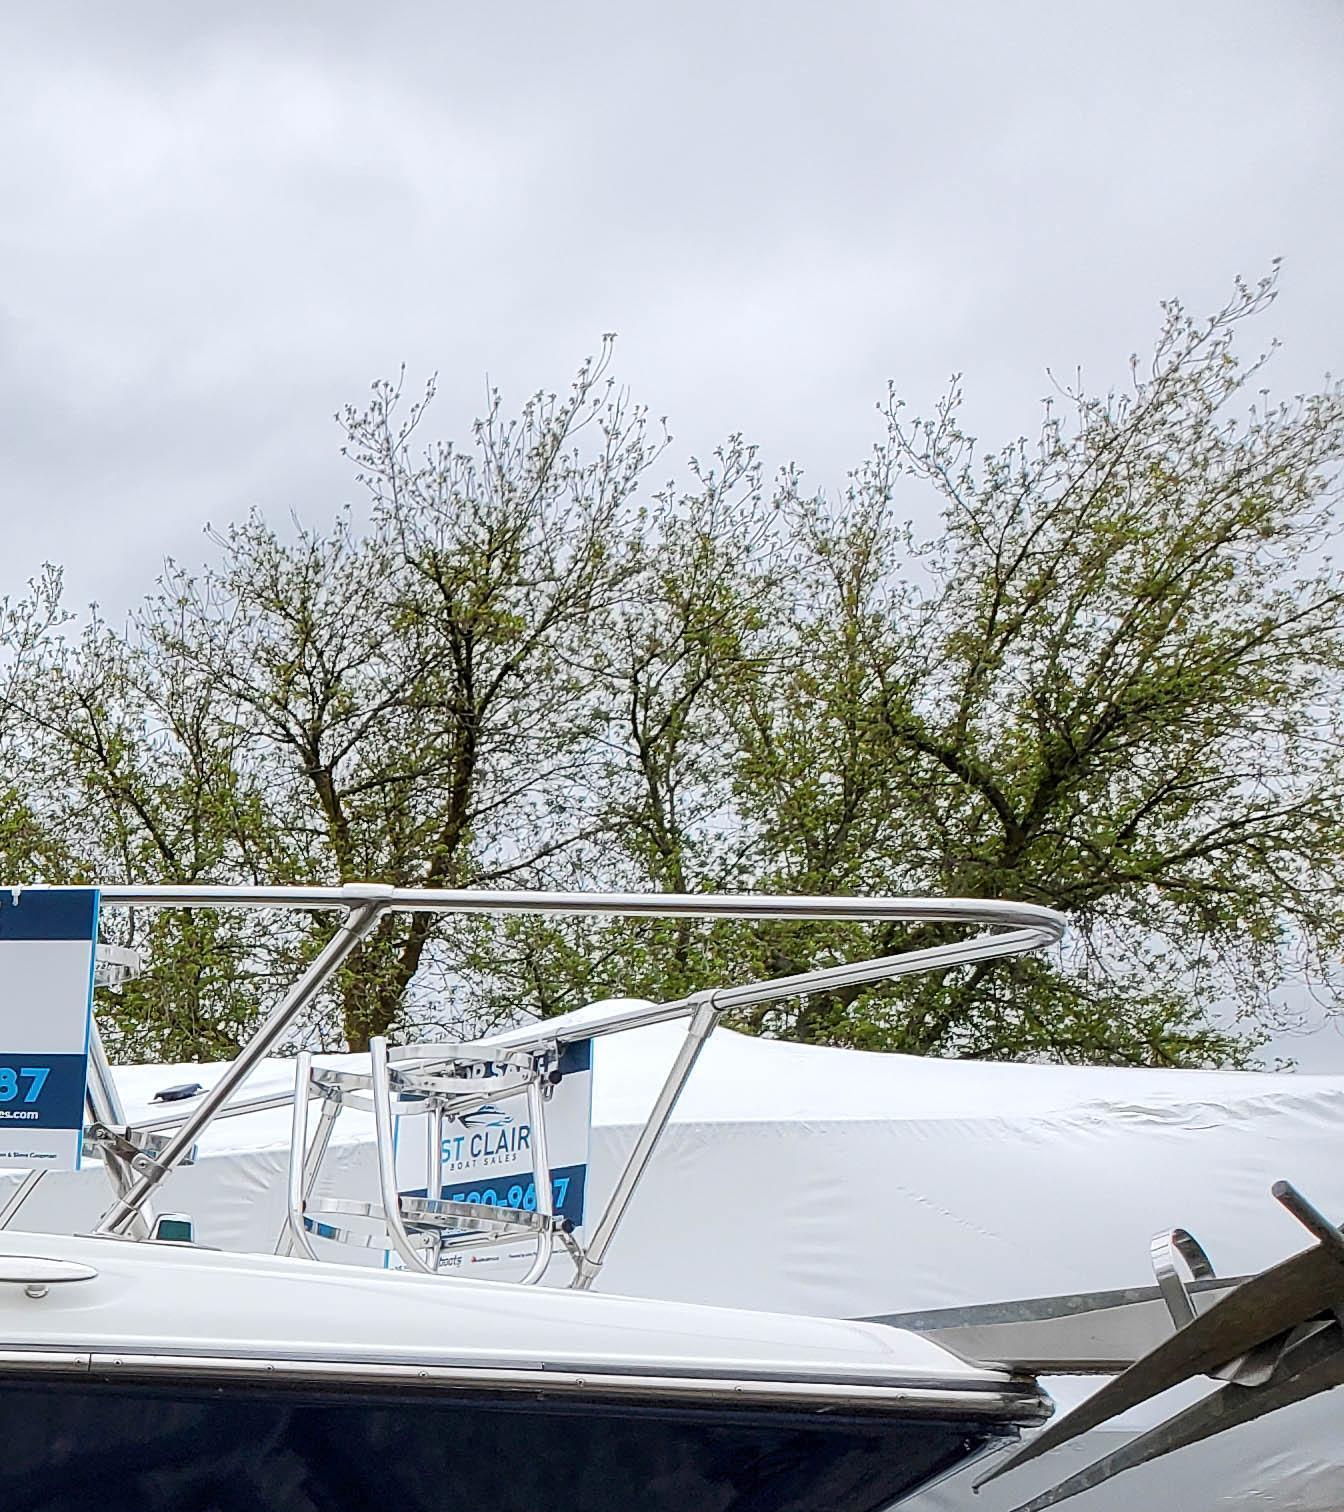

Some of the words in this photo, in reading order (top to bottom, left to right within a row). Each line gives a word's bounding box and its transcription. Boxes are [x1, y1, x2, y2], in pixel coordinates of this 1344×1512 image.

[441, 1136, 465, 1164] ST
[470, 1125, 531, 1158] CLAIR
[484, 1152, 517, 1166] SALES
